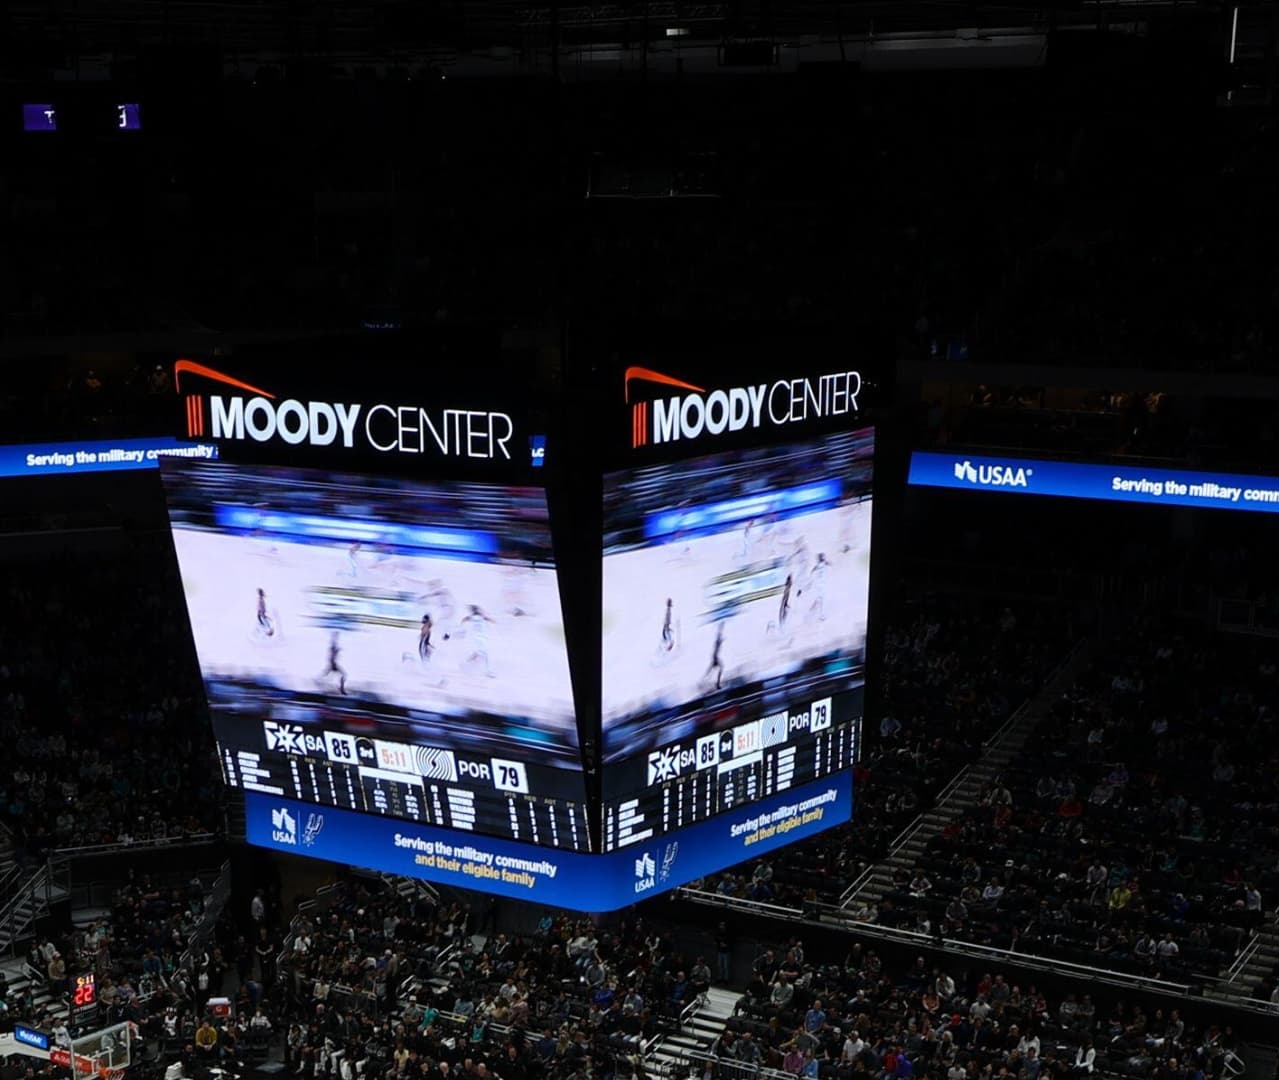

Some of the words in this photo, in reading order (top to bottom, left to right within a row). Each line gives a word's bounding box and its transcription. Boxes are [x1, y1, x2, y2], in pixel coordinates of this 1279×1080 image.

[654, 384, 767, 444] MOODY
[769, 371, 861, 424] CENTER
[210, 396, 361, 448] MOODY
[366, 404, 513, 459] CENTER
[26, 451, 74, 466] Serving
[75, 451, 97, 464] the
[98, 448, 144, 464] military
[979, 465, 1027, 486] USAA
[1112, 476, 1162, 496] Serving
[1165, 480, 1187, 496] the
[1189, 481, 1241, 503] military
[789, 713, 809, 732] POR
[814, 704, 827, 727] 79
[304, 734, 326, 752] SA
[331, 738, 350, 760] 85
[737, 731, 755, 750] 5:11
[381, 749, 407, 767] 5:11
[680, 749, 696, 768] SA
[700, 743, 715, 765] 85
[459, 760, 491, 779] POR
[498, 766, 519, 787] 79
[730, 815, 760, 837] Serving
[760, 811, 772, 826] the
[771, 804, 798, 824] military
[798, 789, 838, 811] community
[272, 831, 296, 845] USAA
[744, 830, 758, 846] and
[801, 808, 824, 828] family
[394, 834, 433, 851] Serving
[435, 841, 452, 856] the
[454, 846, 493, 867] military
[496, 854, 557, 877] community
[415, 853, 434, 866] and
[436, 857, 460, 873] their
[462, 861, 499, 880] eligible
[501, 869, 535, 888] family
[635, 878, 655, 893] USAA
